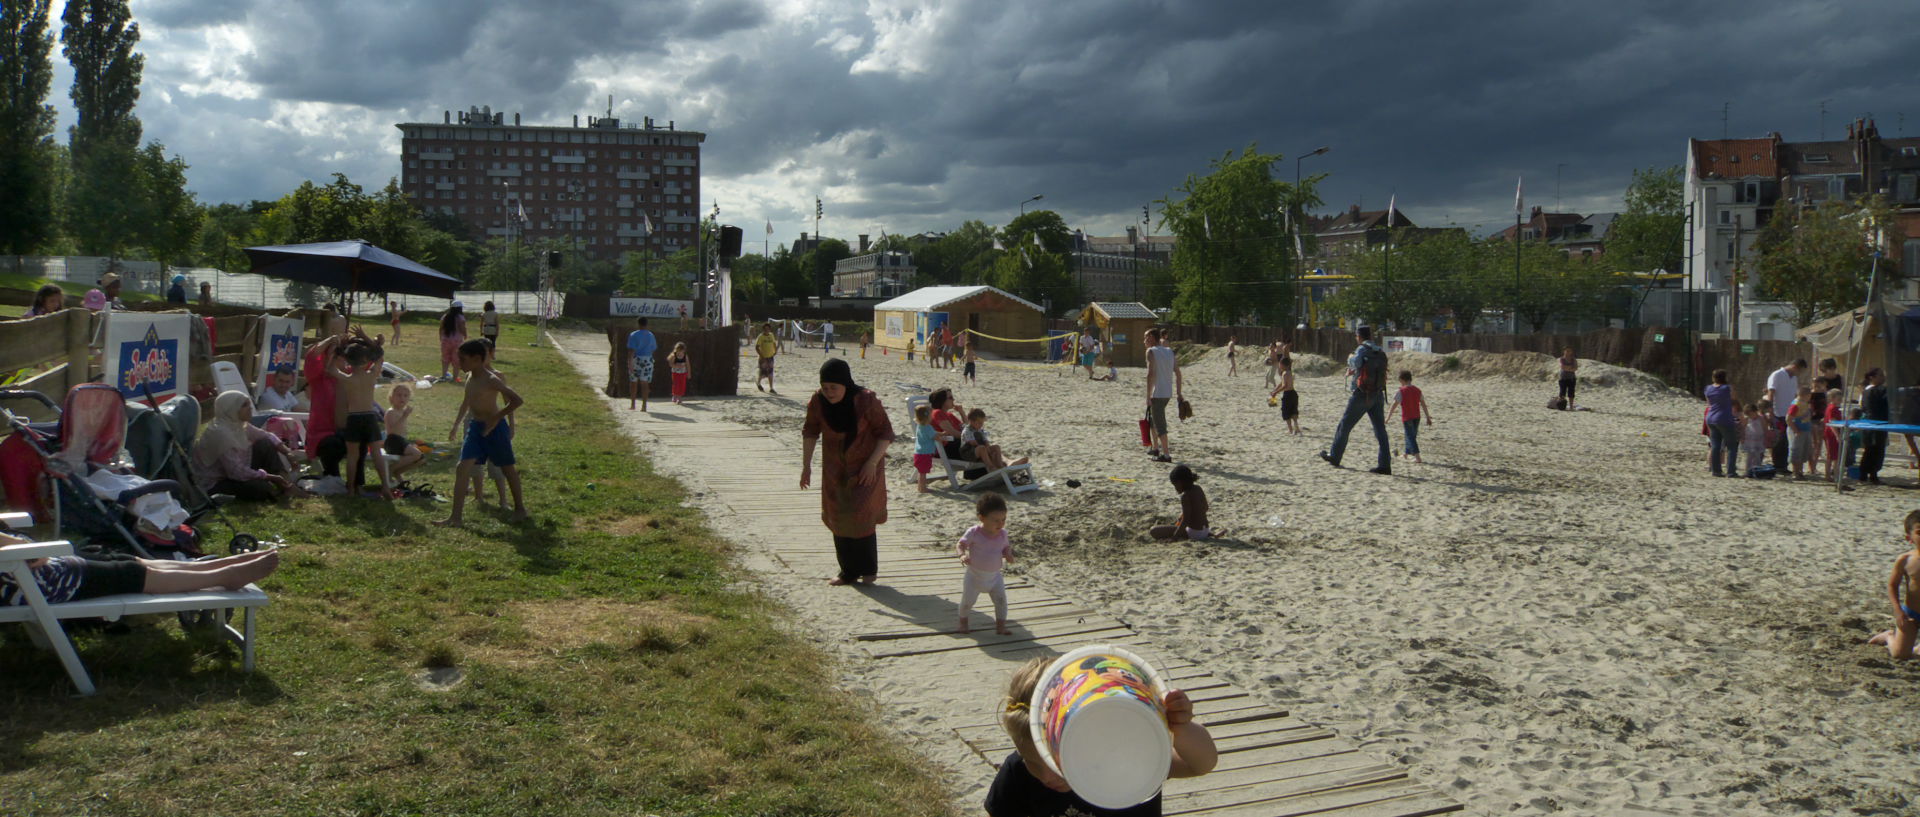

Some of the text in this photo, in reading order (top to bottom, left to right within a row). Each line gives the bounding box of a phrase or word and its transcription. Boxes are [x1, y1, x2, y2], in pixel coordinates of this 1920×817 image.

[615, 302, 674, 315] Ville de Lille
